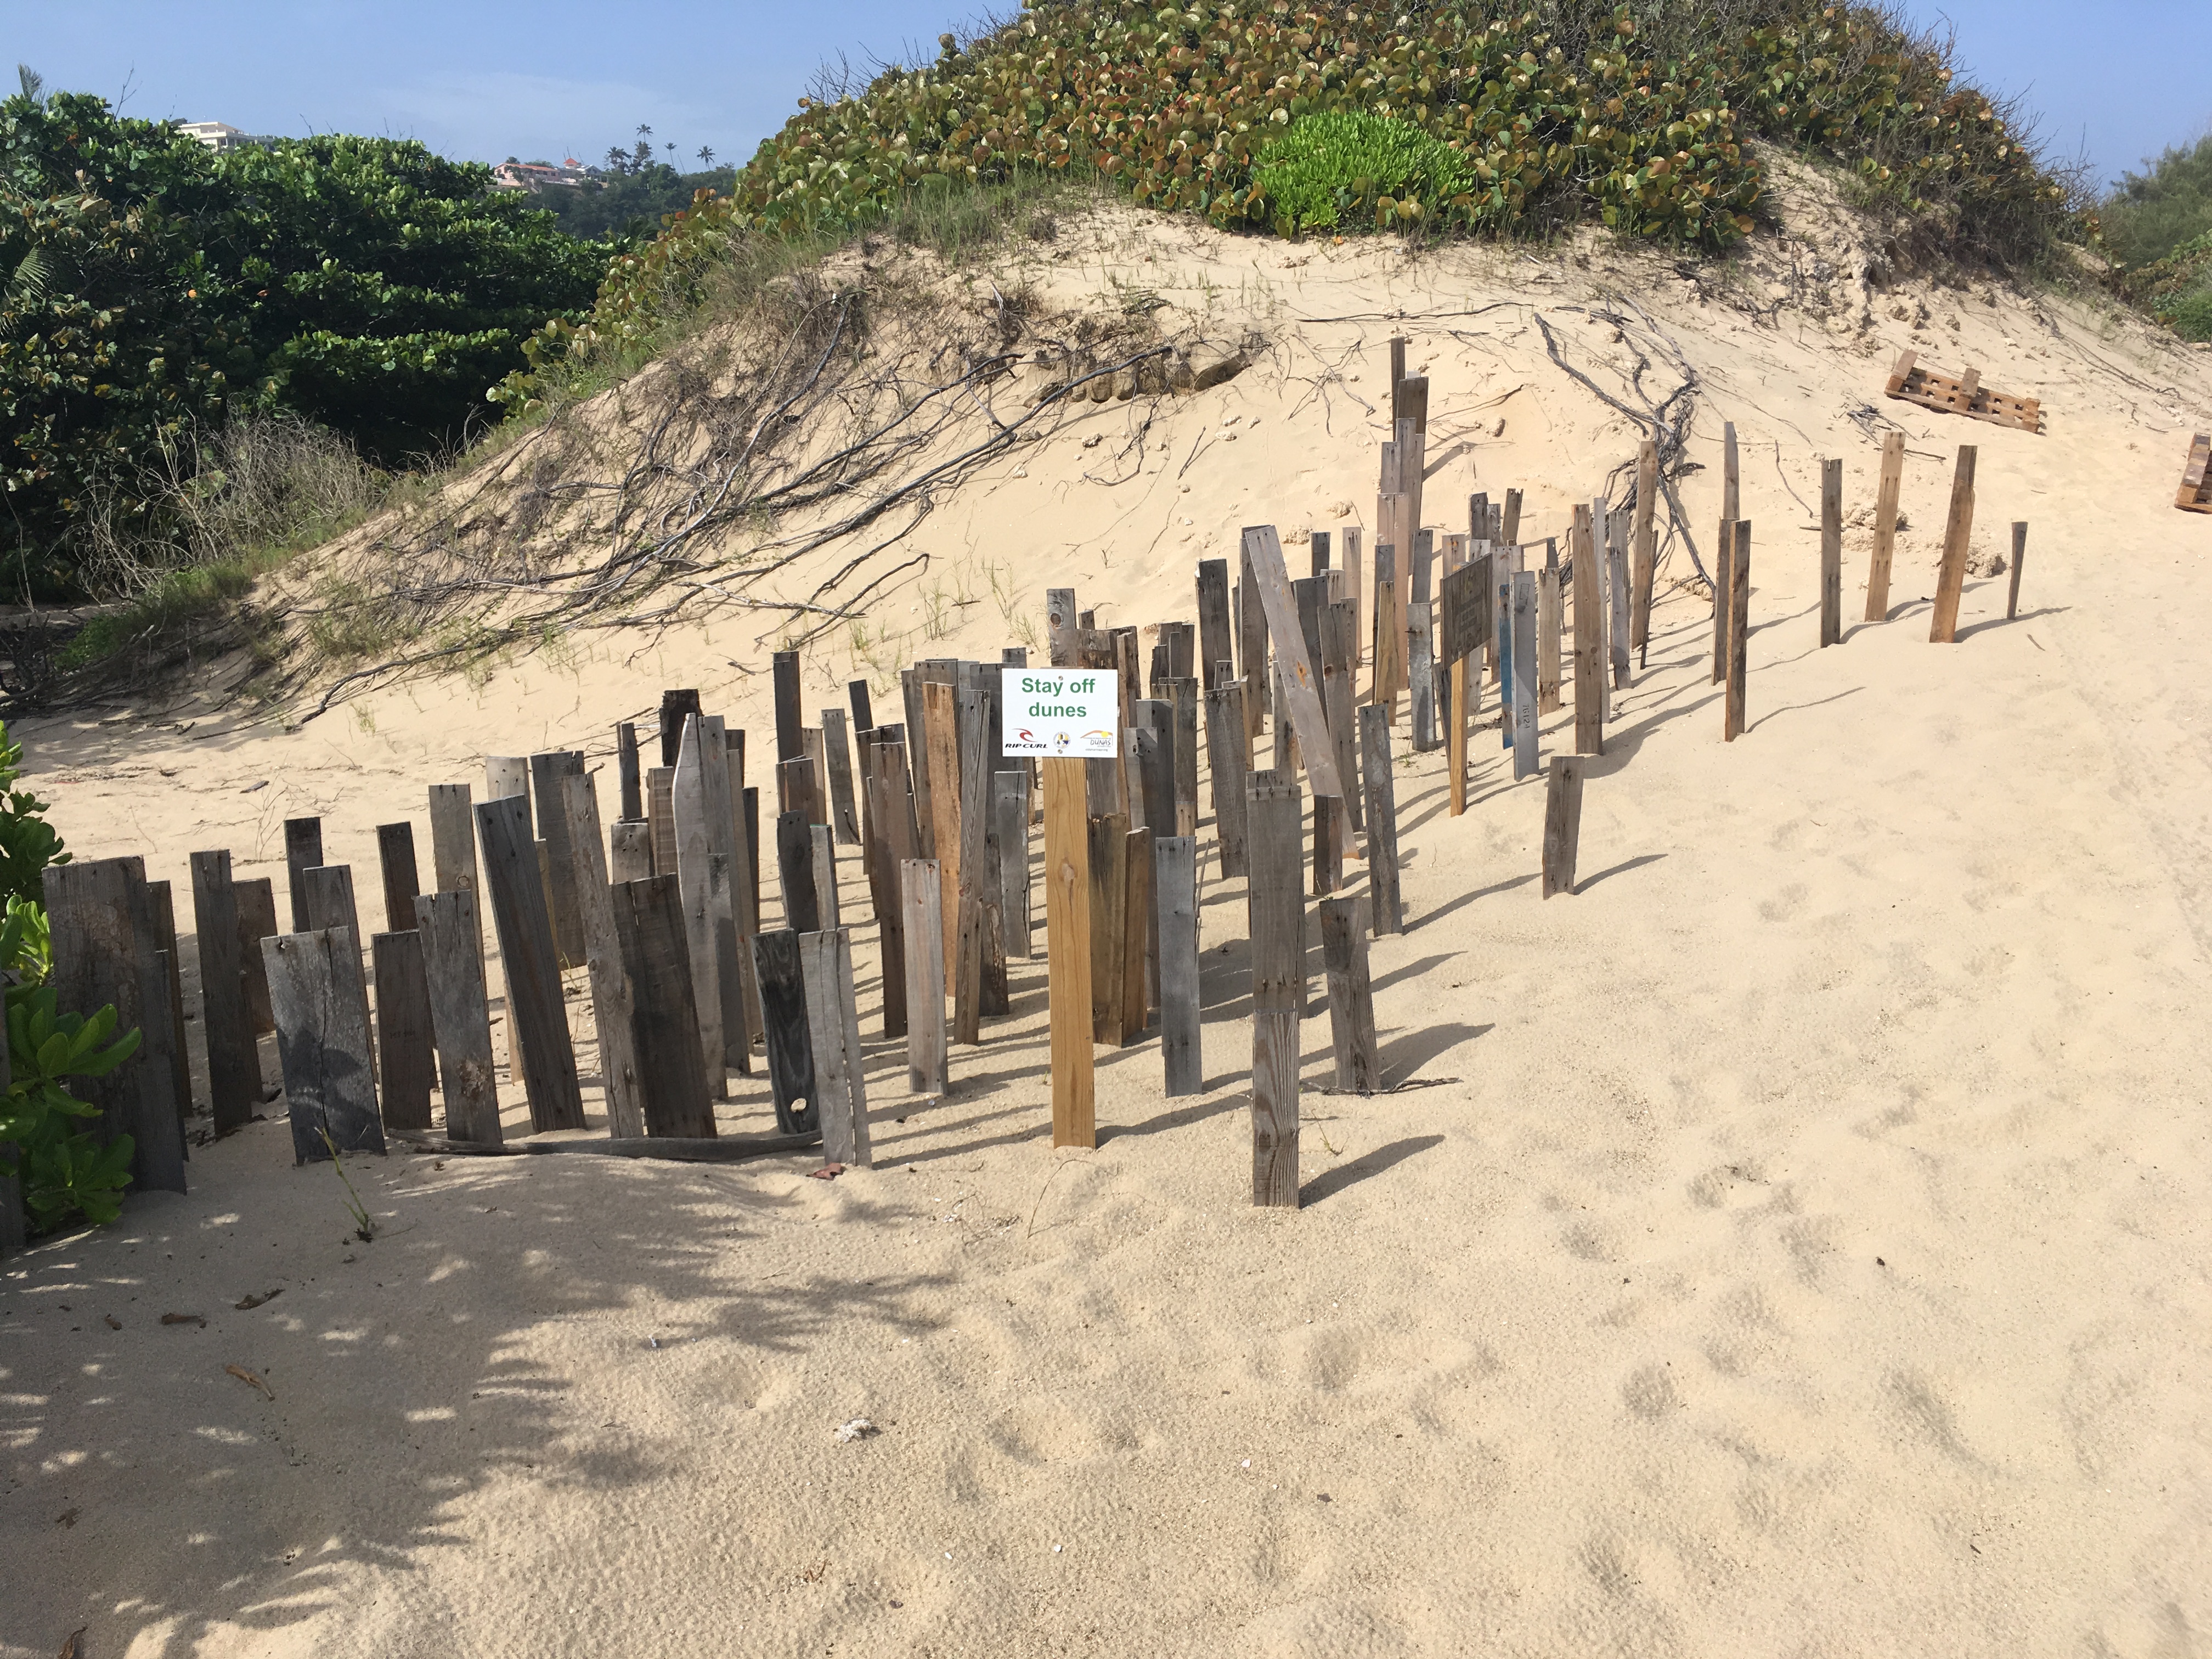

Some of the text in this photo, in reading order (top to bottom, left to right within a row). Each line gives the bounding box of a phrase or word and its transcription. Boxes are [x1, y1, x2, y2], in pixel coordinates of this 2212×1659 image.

[1022, 678, 1096, 697] Stay off
[1029, 702, 1087, 718] dunes
